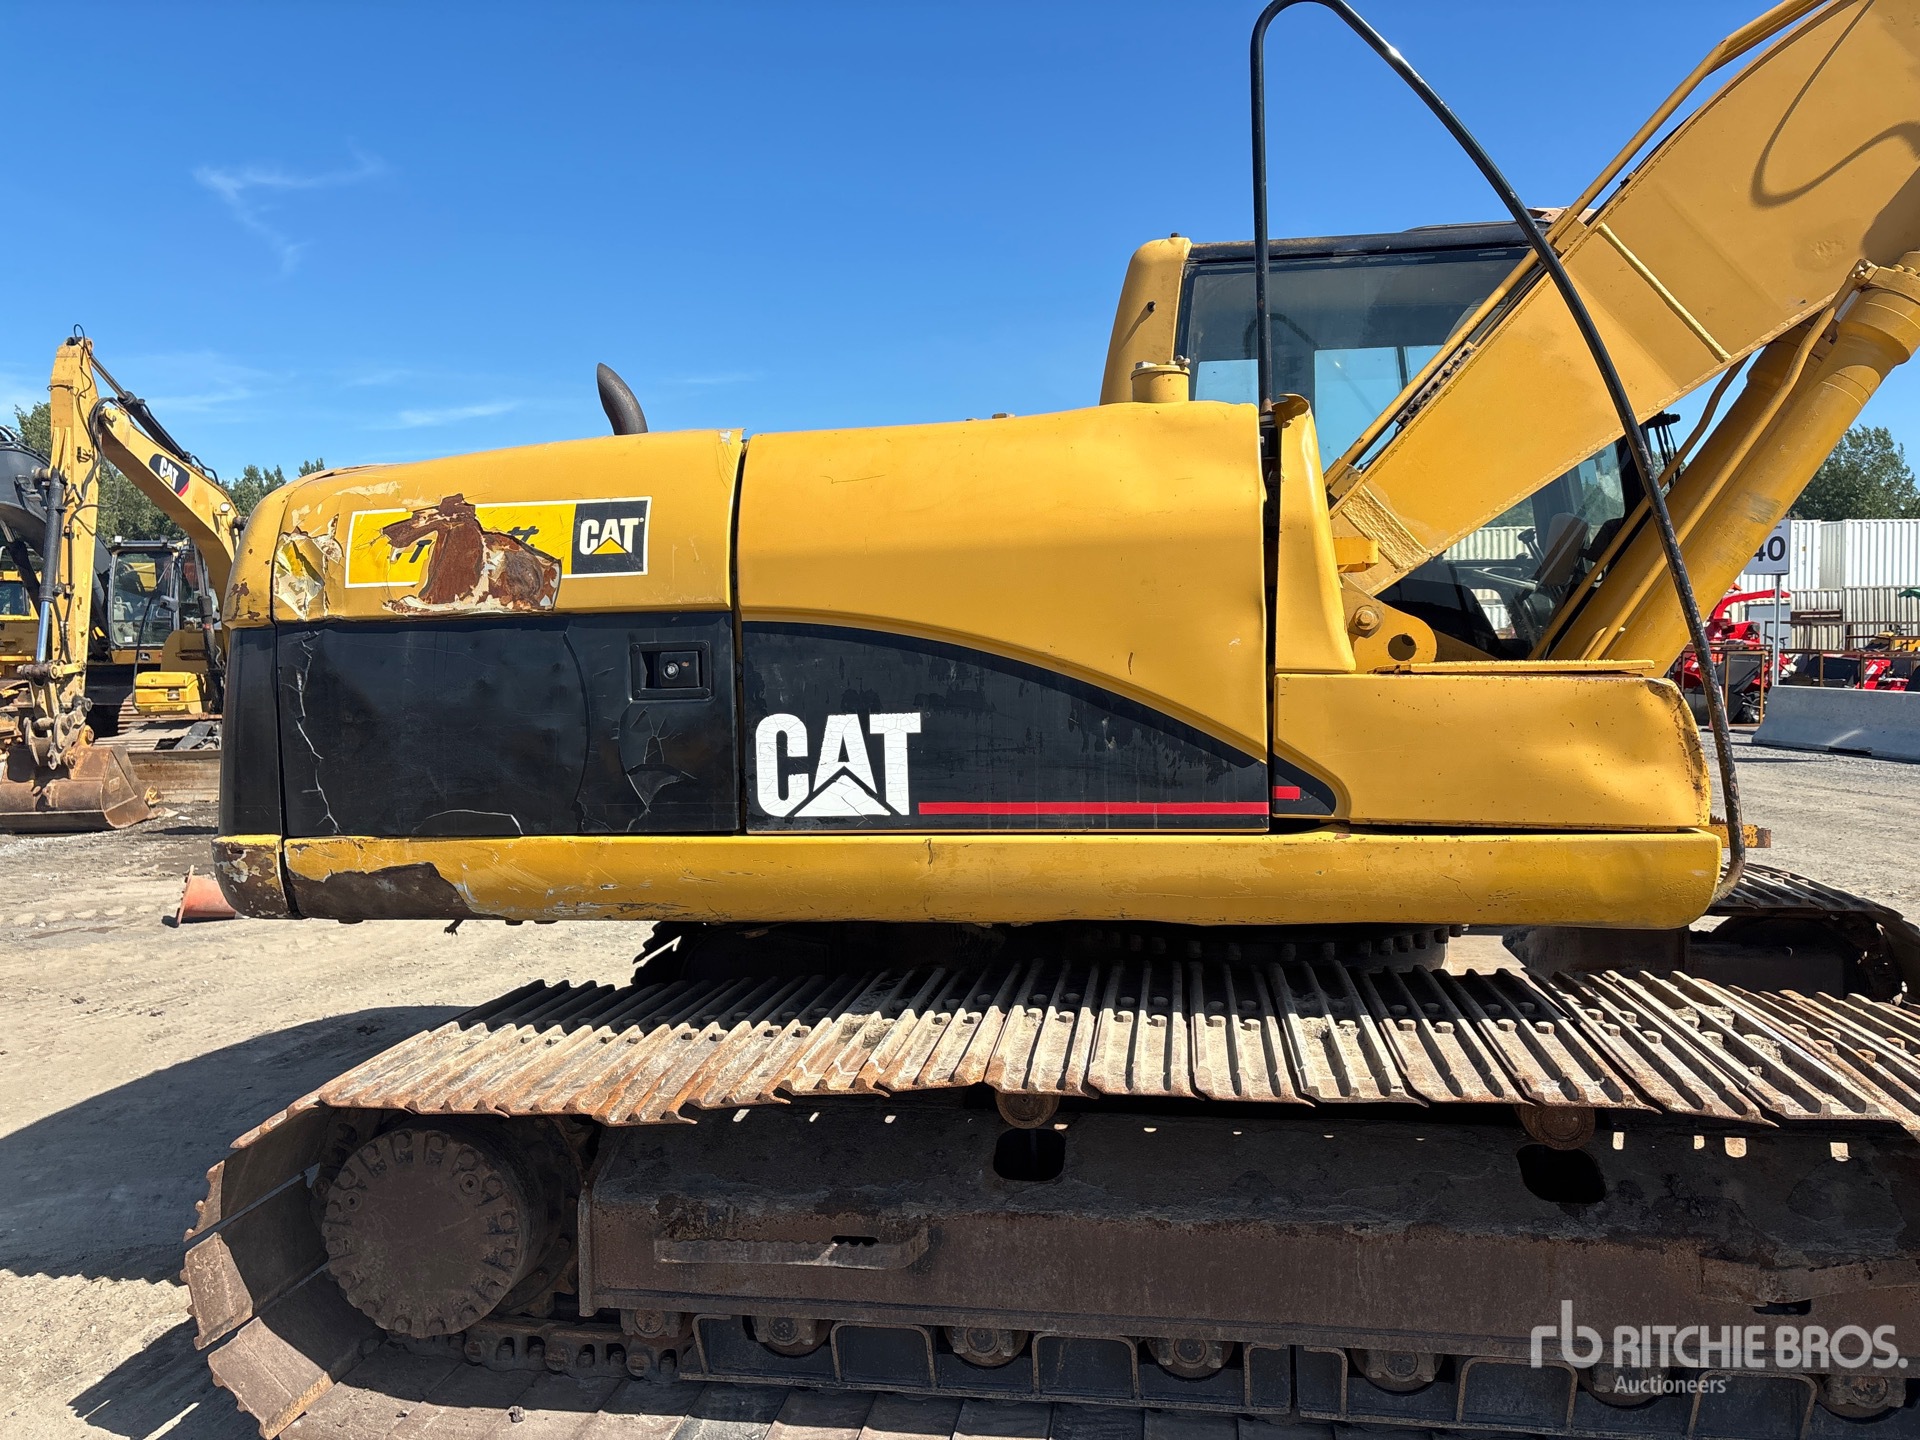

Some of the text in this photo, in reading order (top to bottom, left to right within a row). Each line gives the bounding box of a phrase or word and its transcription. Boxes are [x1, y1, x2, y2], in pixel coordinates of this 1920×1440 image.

[159, 456, 179, 490] CAT
[579, 517, 641, 556] CAT
[755, 712, 922, 817] CAT
